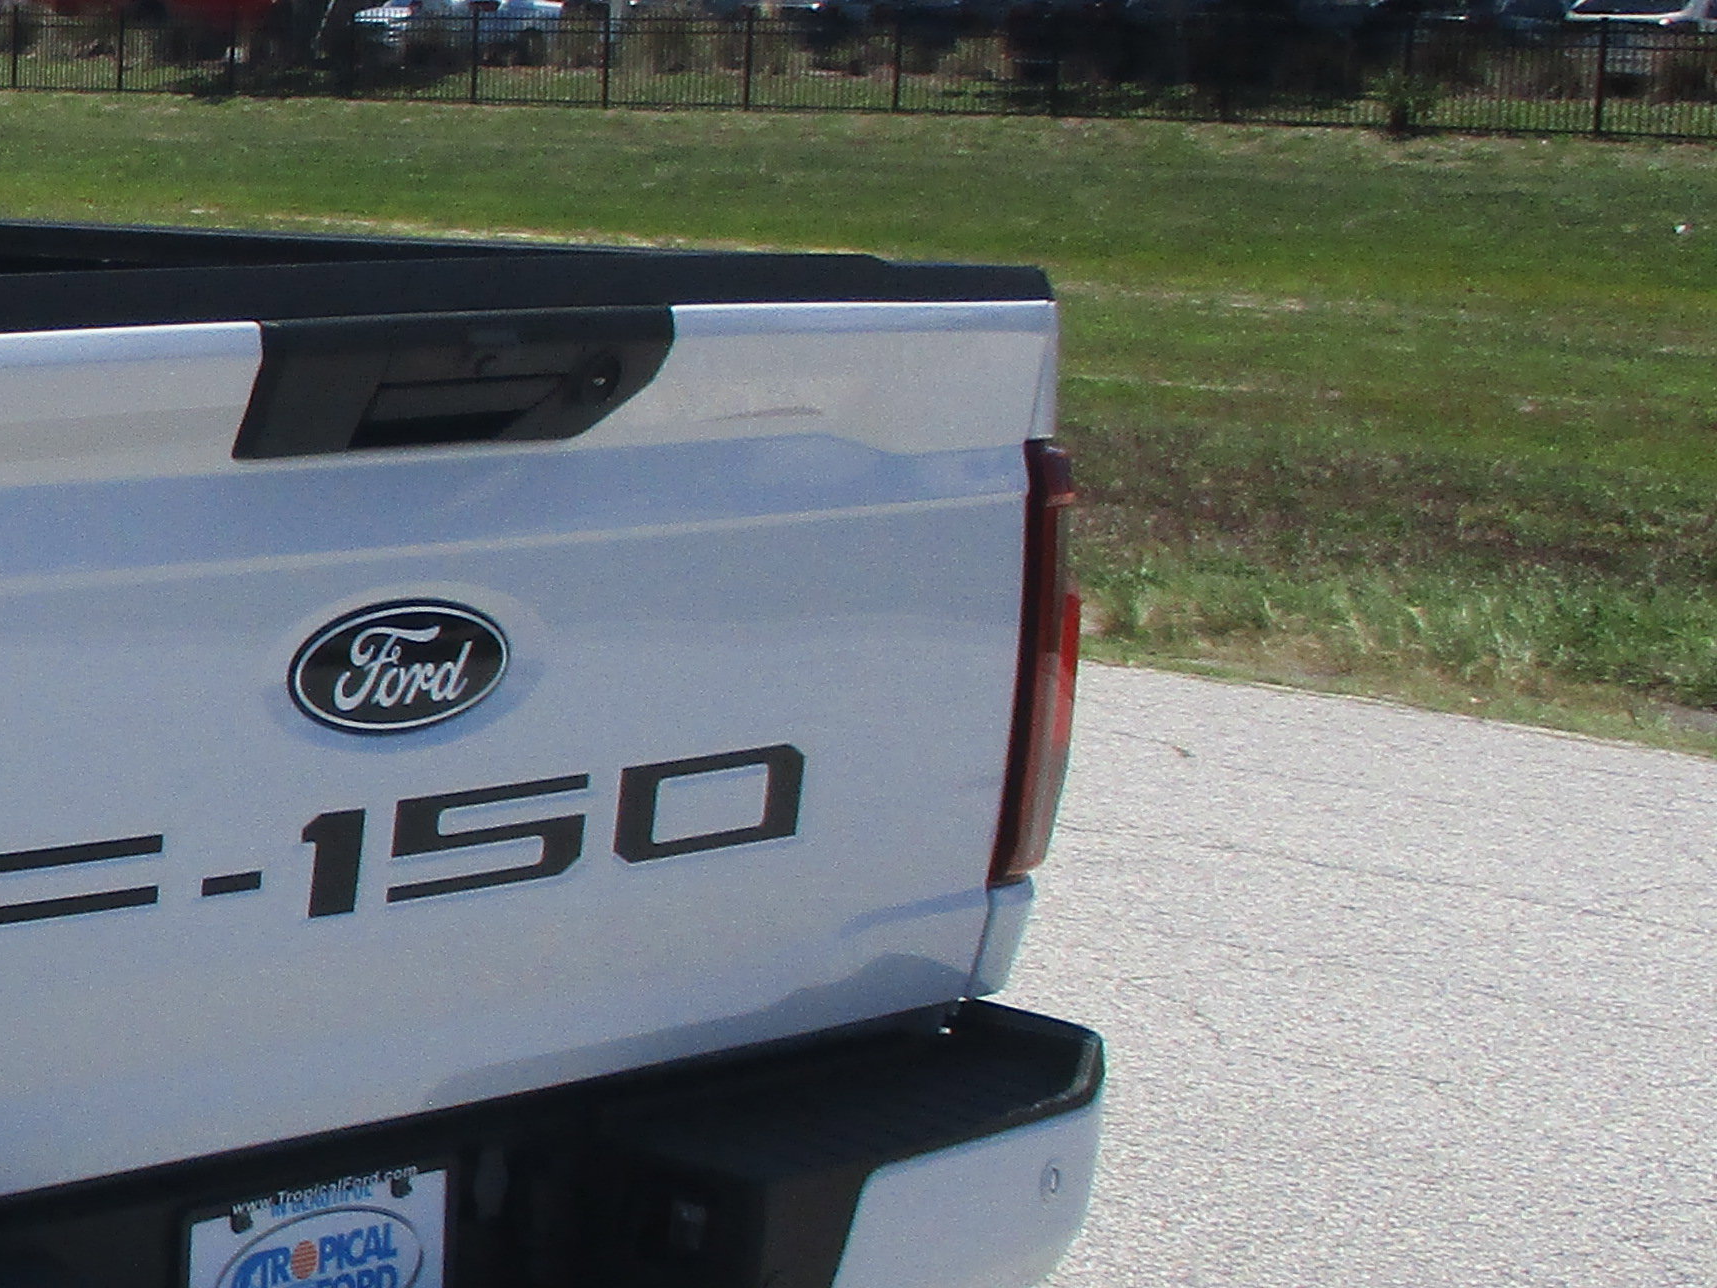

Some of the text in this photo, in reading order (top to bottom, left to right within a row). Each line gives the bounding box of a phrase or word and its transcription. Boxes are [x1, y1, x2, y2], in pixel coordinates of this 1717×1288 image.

[334, 626, 475, 712] Ford
[232, 1165, 418, 1214] www.TropicalFord.com
[237, 1222, 397, 1287] TROPICAL
